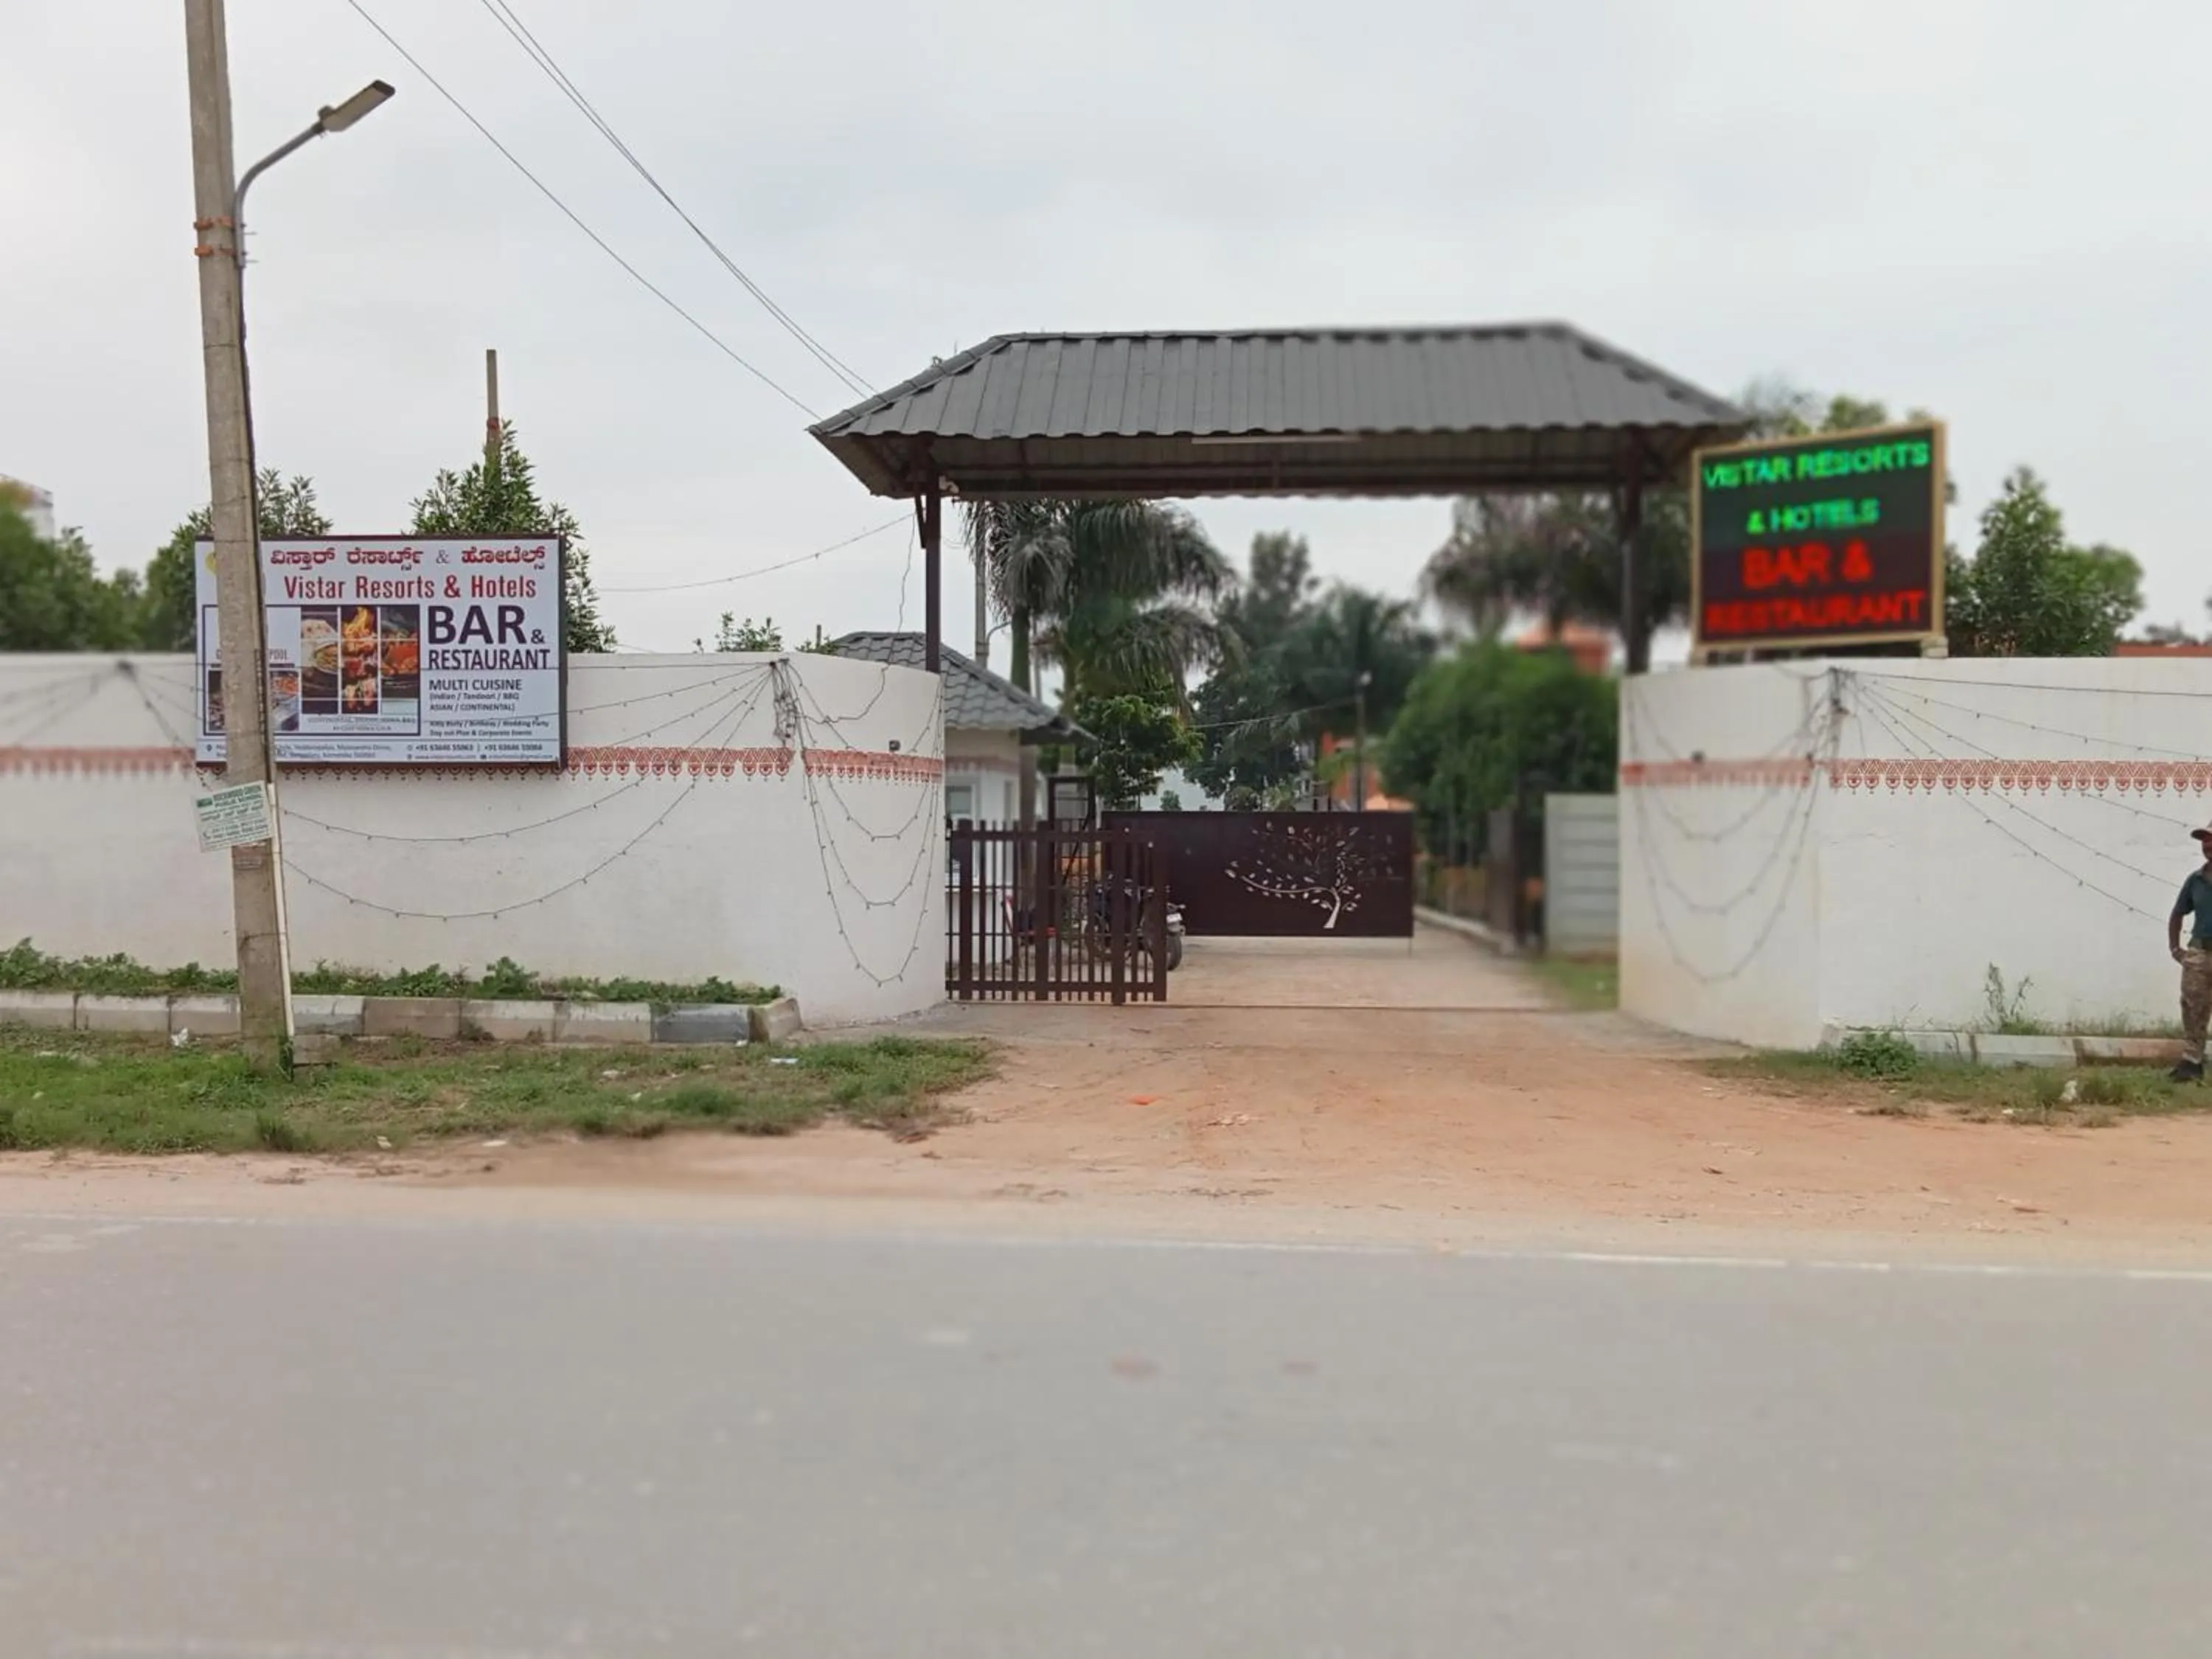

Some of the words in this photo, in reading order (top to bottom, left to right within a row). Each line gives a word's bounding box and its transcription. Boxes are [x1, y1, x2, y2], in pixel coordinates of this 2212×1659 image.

[1704, 456, 1792, 489] VISTAR
[1796, 440, 1930, 479] RESORTS
[1746, 510, 1765, 535] &
[1770, 498, 1879, 533] HOTELS
[436, 549, 450, 564] &
[1741, 542, 1832, 589] BAR
[1841, 537, 1874, 582] &
[284, 575, 346, 599] Vistar
[356, 575, 435, 599] Resorts
[444, 574, 461, 598] &
[471, 575, 537, 598] Hotels
[428, 605, 527, 644] BAR
[530, 629, 546, 644] &
[1704, 591, 1925, 632] RESTAURANT
[428, 649, 551, 670] RESTAURANT
[429, 679, 468, 691] MULTI
[472, 679, 522, 691] CUISINE
